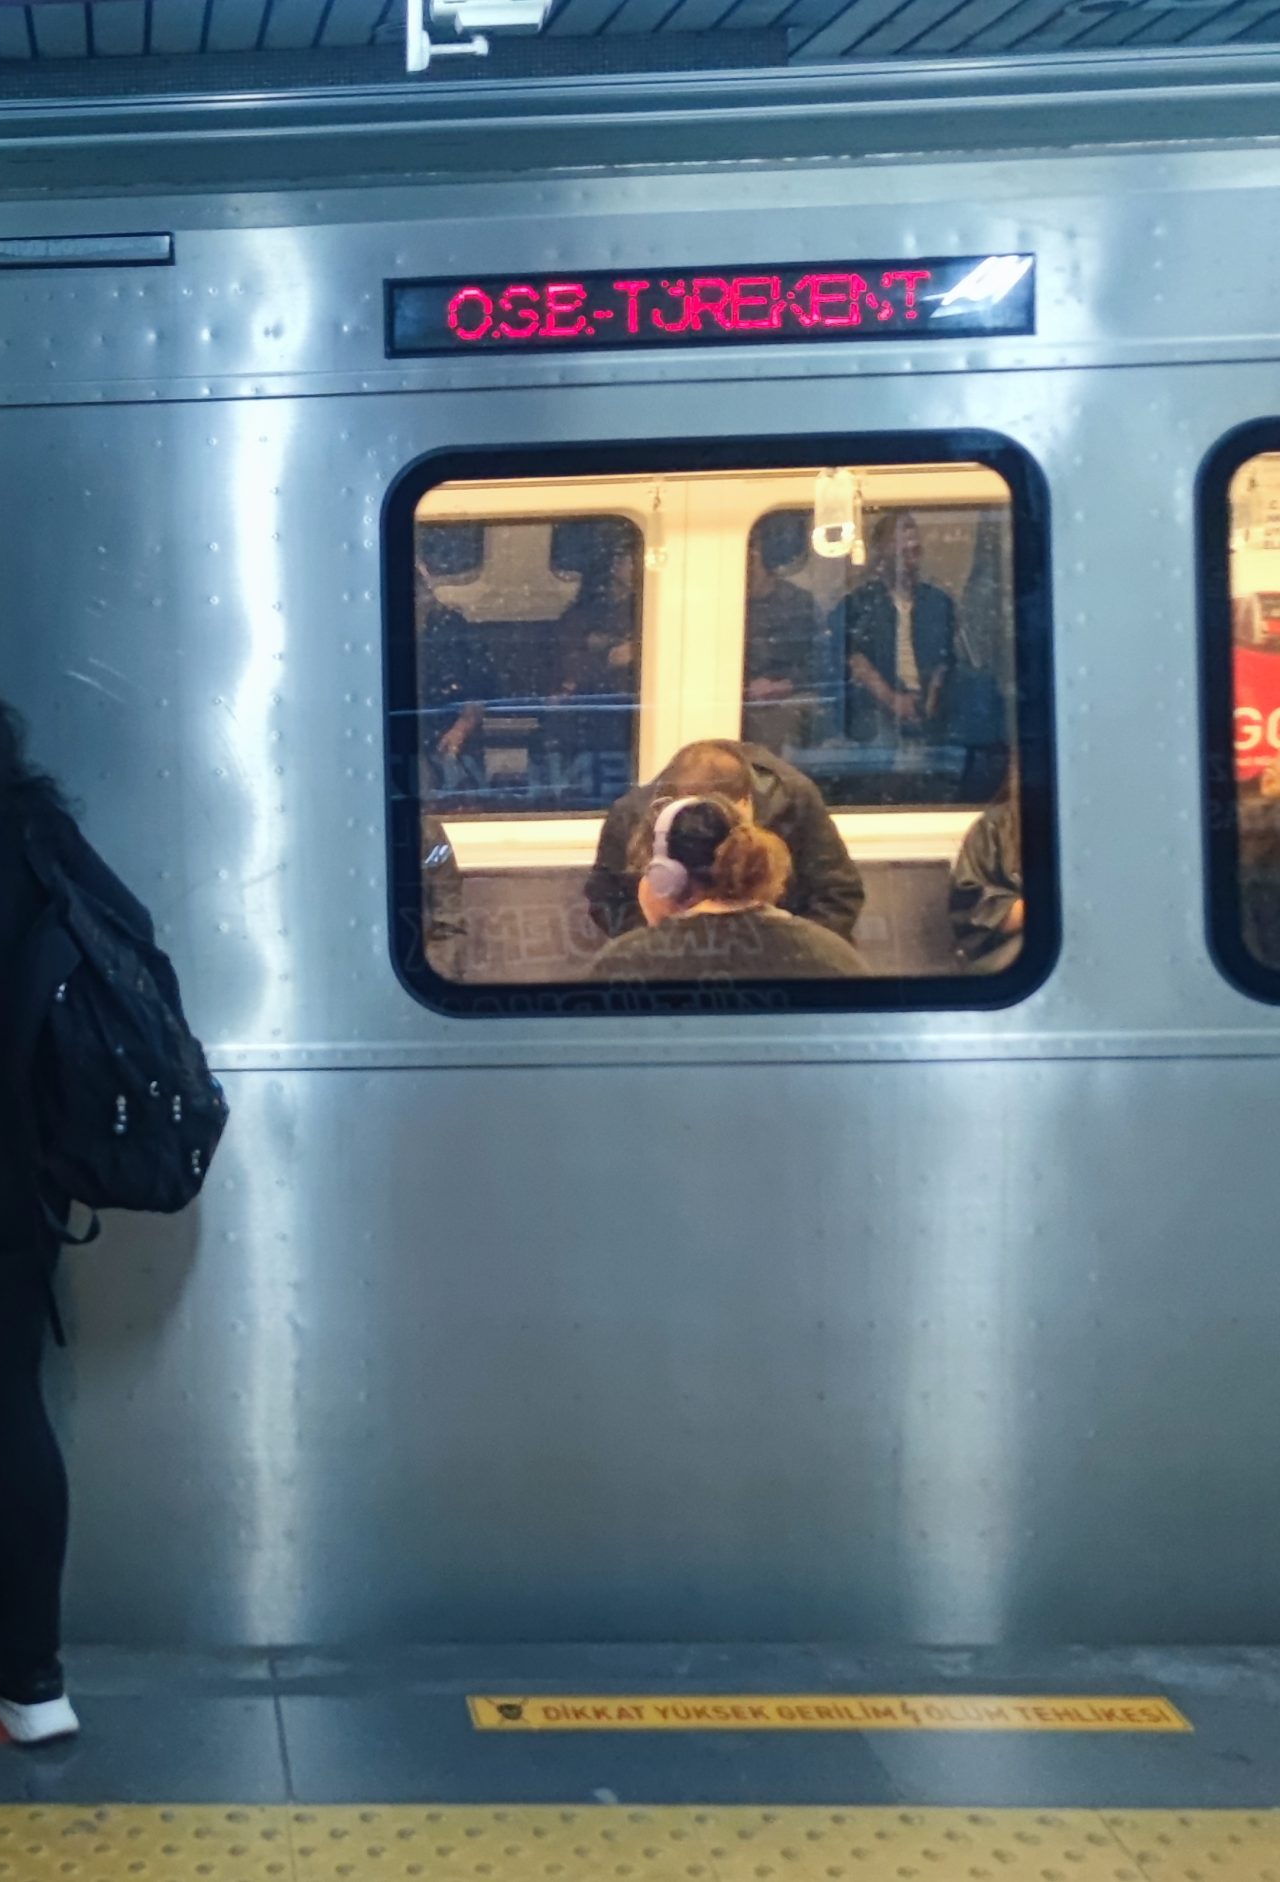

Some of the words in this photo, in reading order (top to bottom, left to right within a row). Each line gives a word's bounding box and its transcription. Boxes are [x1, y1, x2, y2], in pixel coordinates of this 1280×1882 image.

[541, 1702, 646, 1721] DİKKAT
[654, 1701, 770, 1721] YÜKSEK
[775, 1700, 899, 1722] GERİLİM
[1012, 1702, 1172, 1723] TEHLİKESİ
